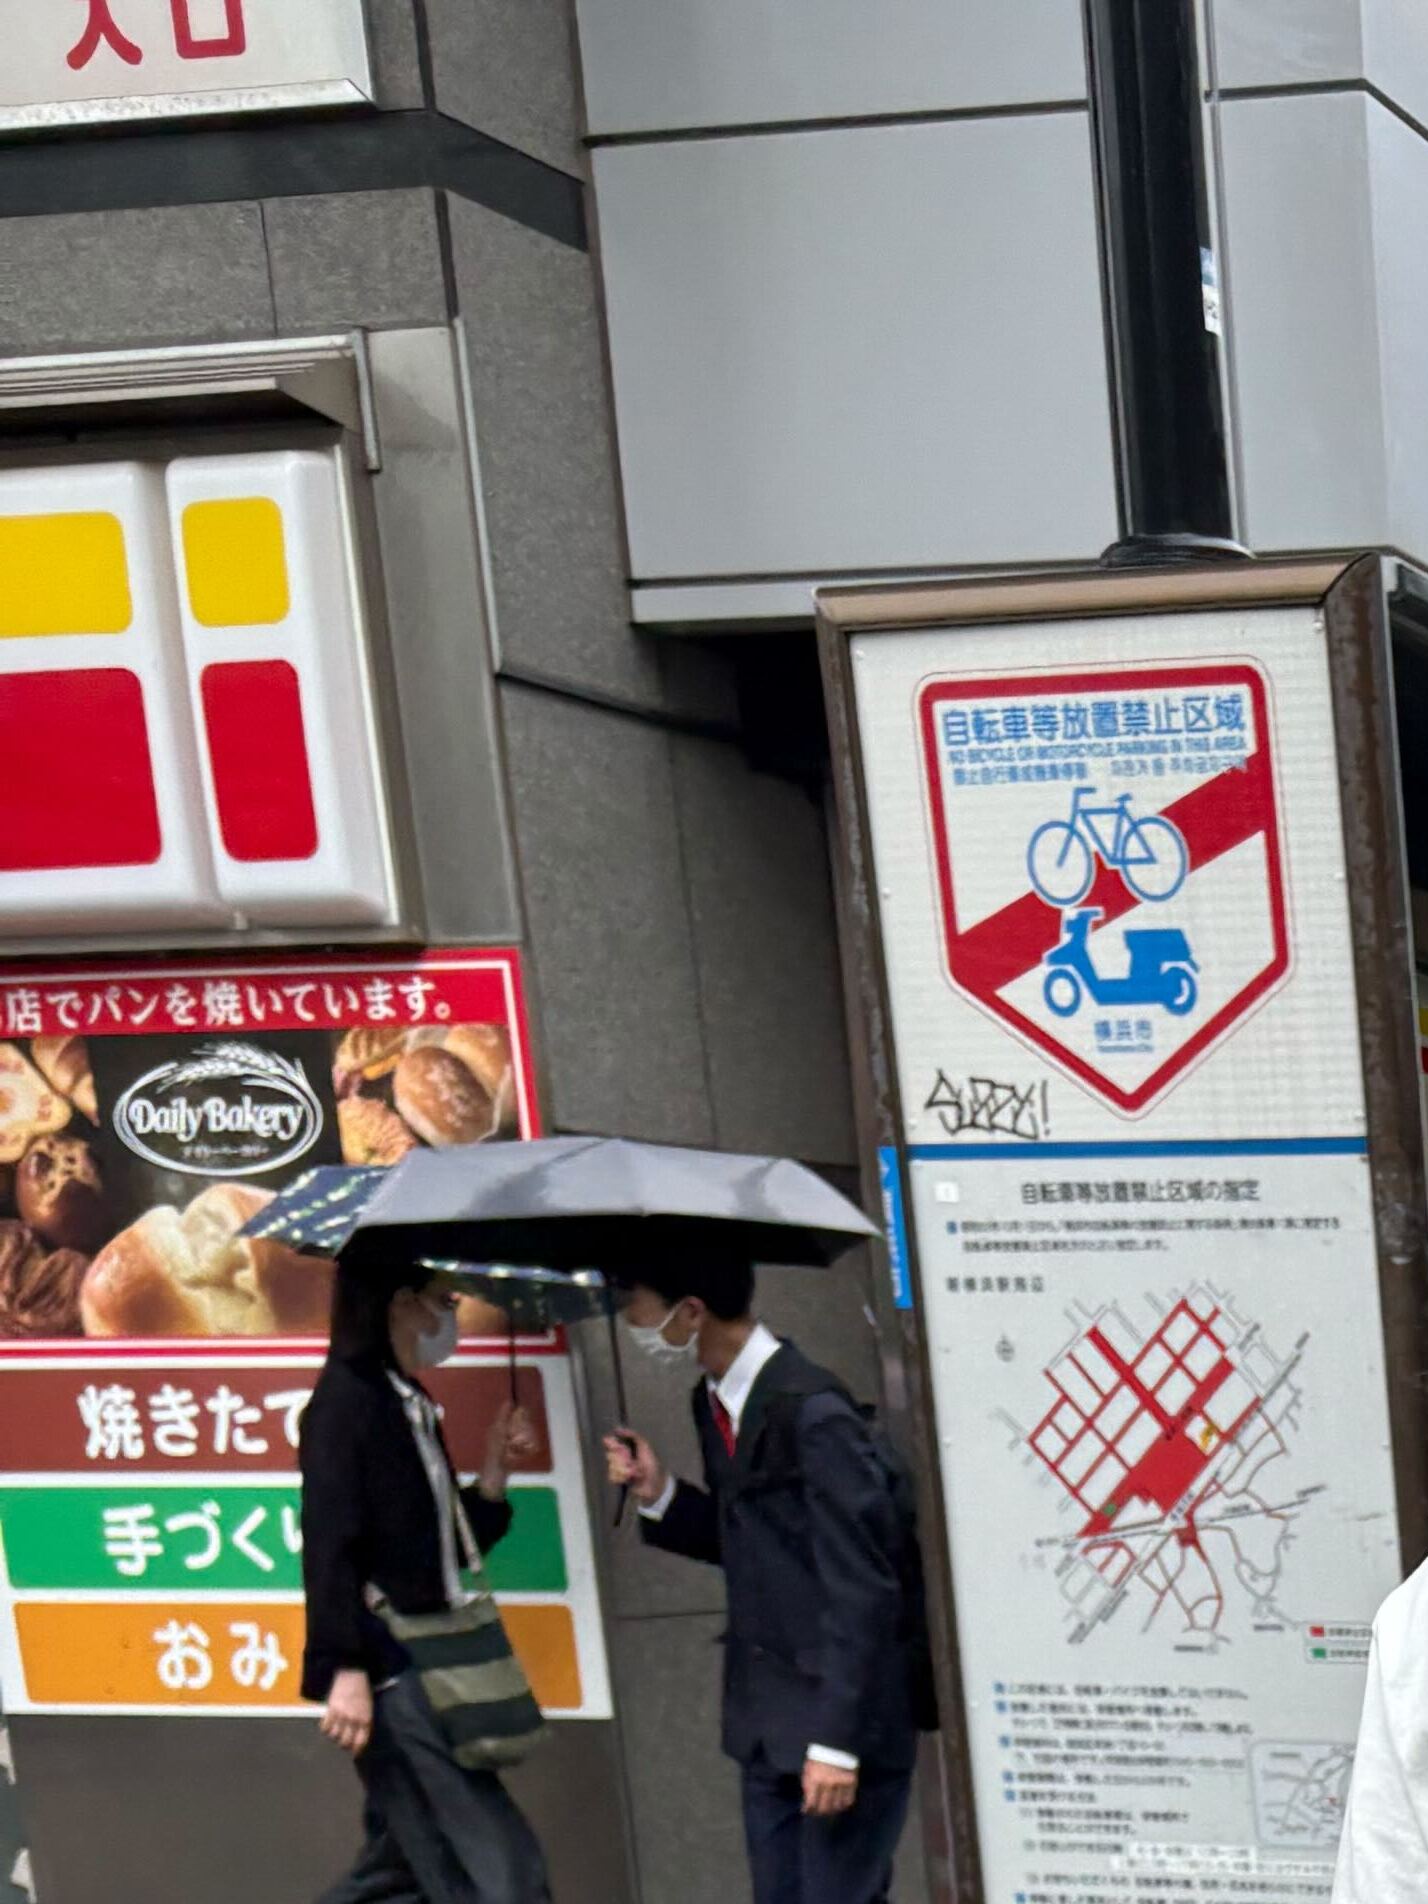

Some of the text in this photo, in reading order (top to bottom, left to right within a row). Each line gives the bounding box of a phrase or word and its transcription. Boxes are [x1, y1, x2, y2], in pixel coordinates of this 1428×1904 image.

[942, 693, 1245, 747] 自転車等放置禁止区域
[0, 976, 451, 1032] 店でパンを焼いています。
[129, 1093, 304, 1143] Daily Bakery
[153, 1620, 288, 1690] おみ
